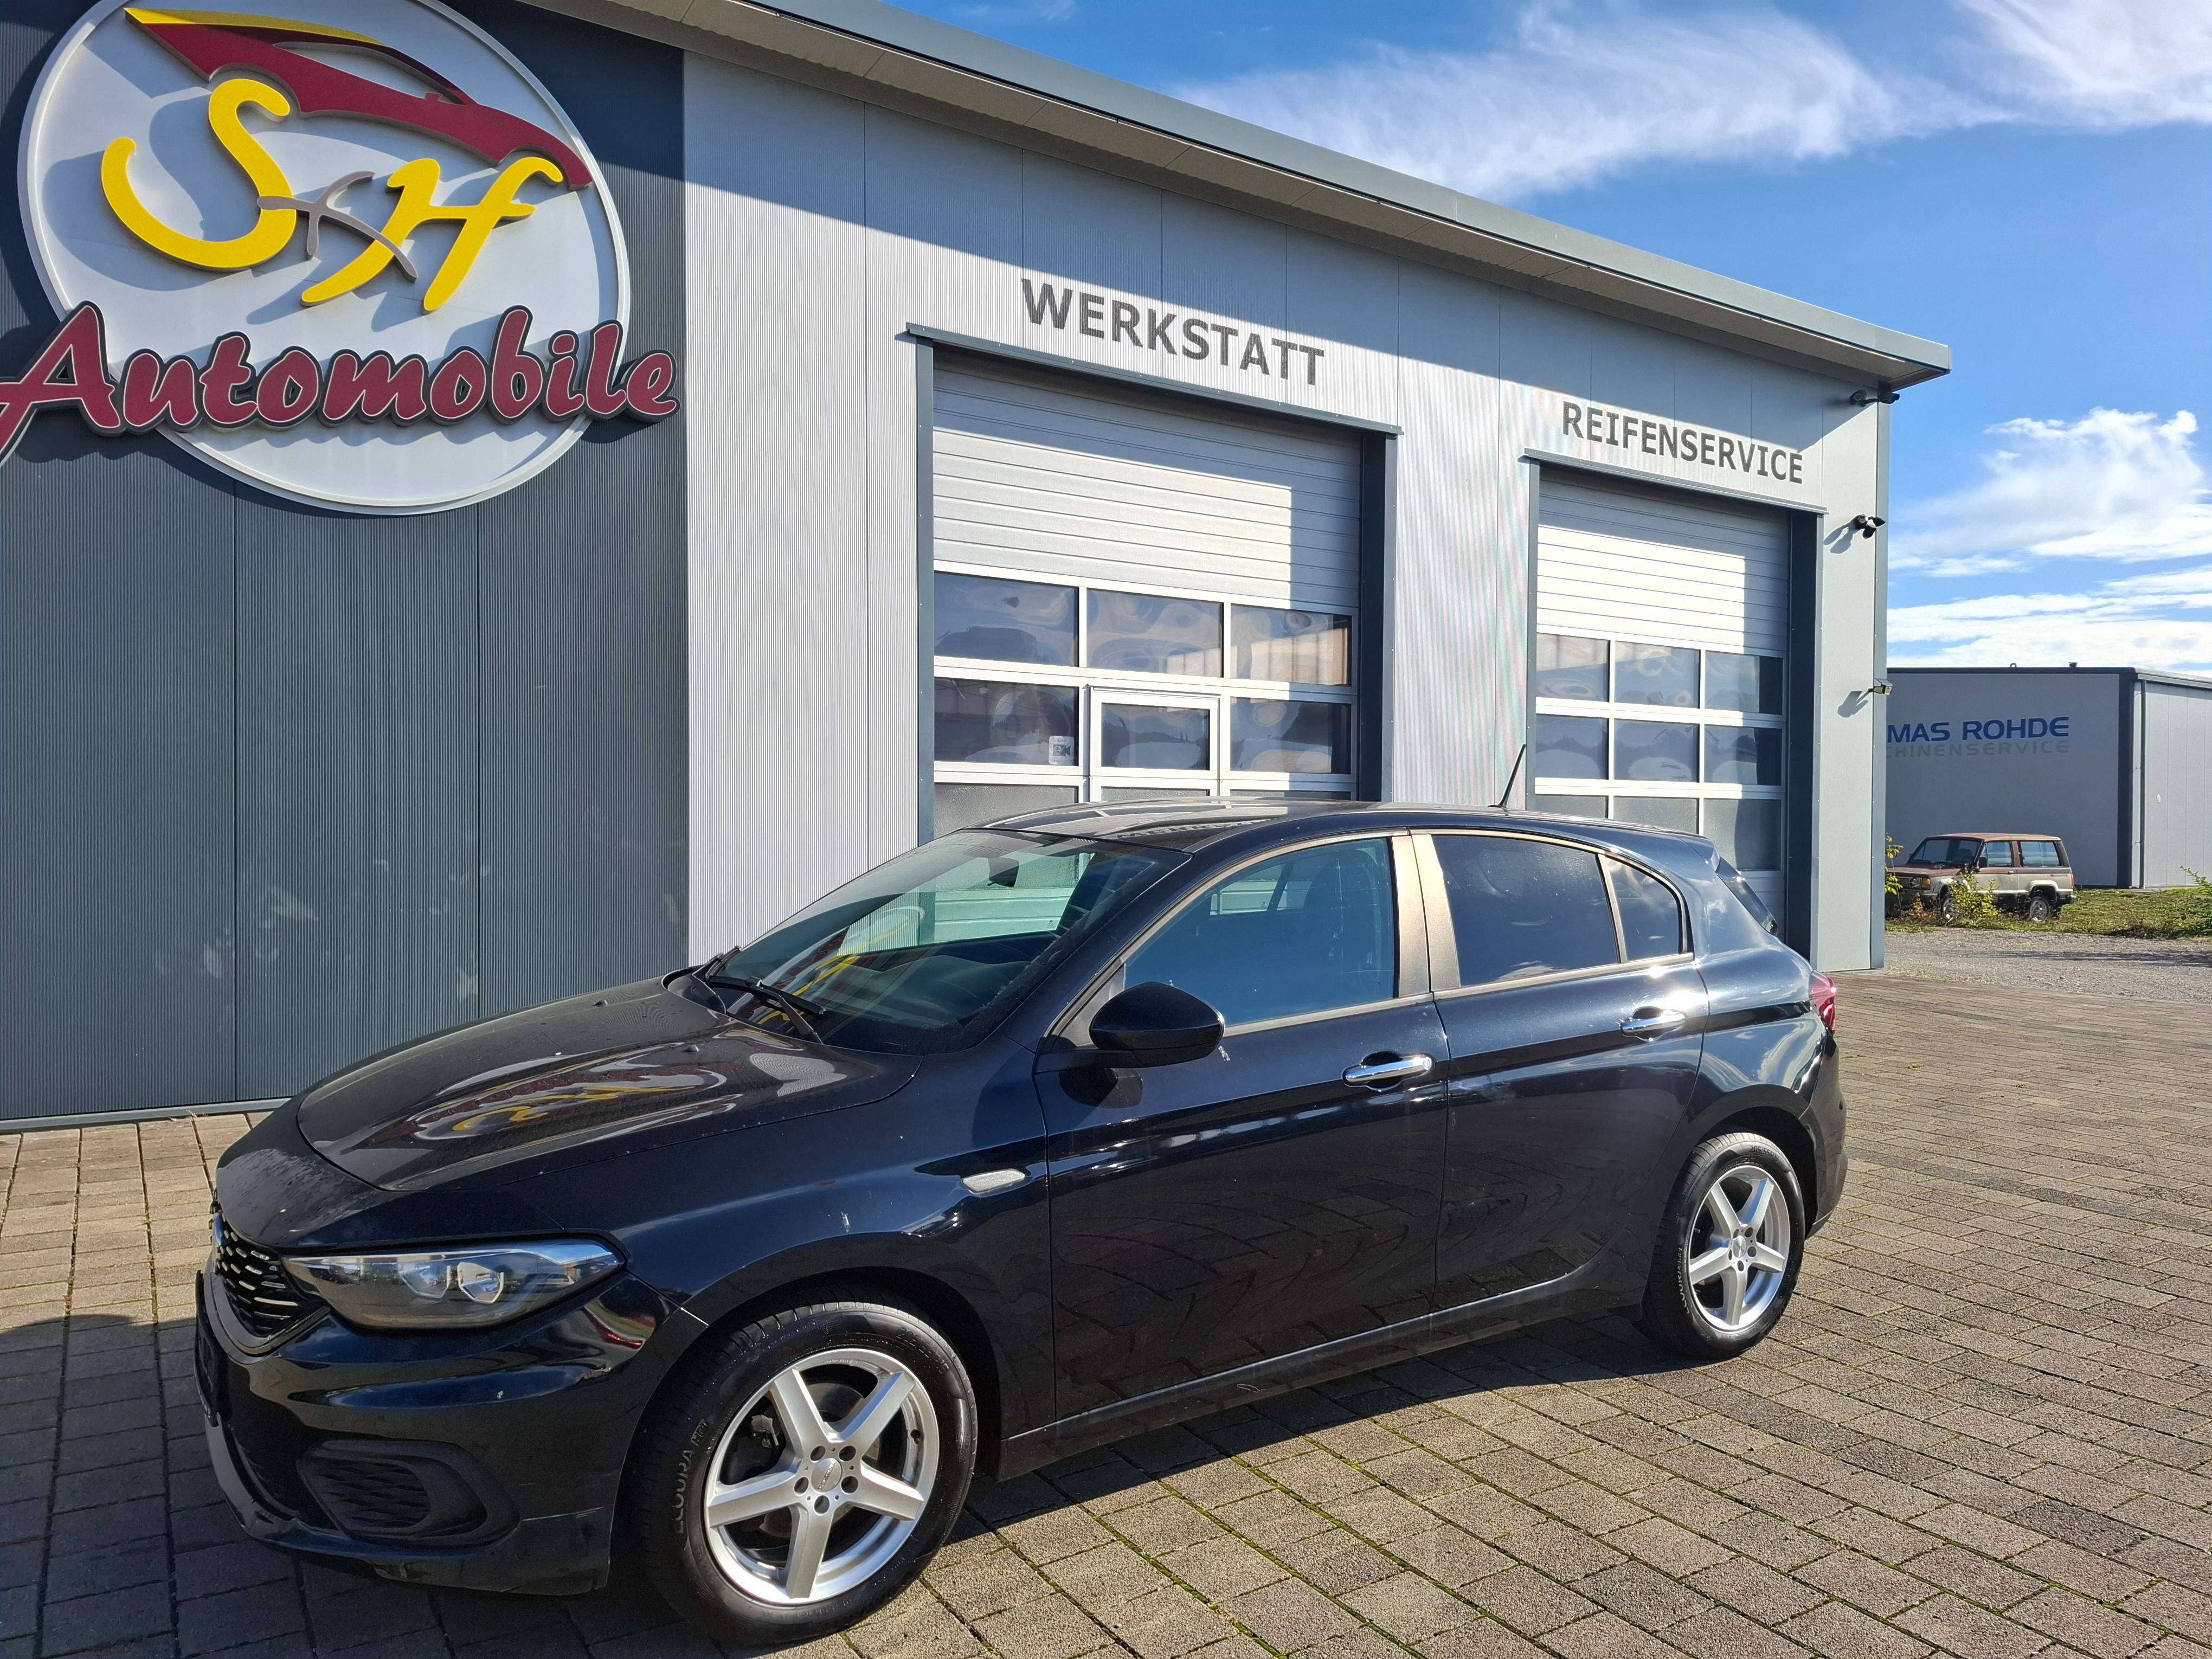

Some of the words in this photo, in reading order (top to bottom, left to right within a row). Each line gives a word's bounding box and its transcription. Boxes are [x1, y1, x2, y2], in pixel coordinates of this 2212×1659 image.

[1020, 278, 1324, 385] WERKSTATT
[0, 300, 681, 467] Automobile
[1562, 401, 1803, 484] REIFENSERVICE
[1887, 722, 1951, 743] MAS
[1962, 716, 2069, 740] ROHDE
